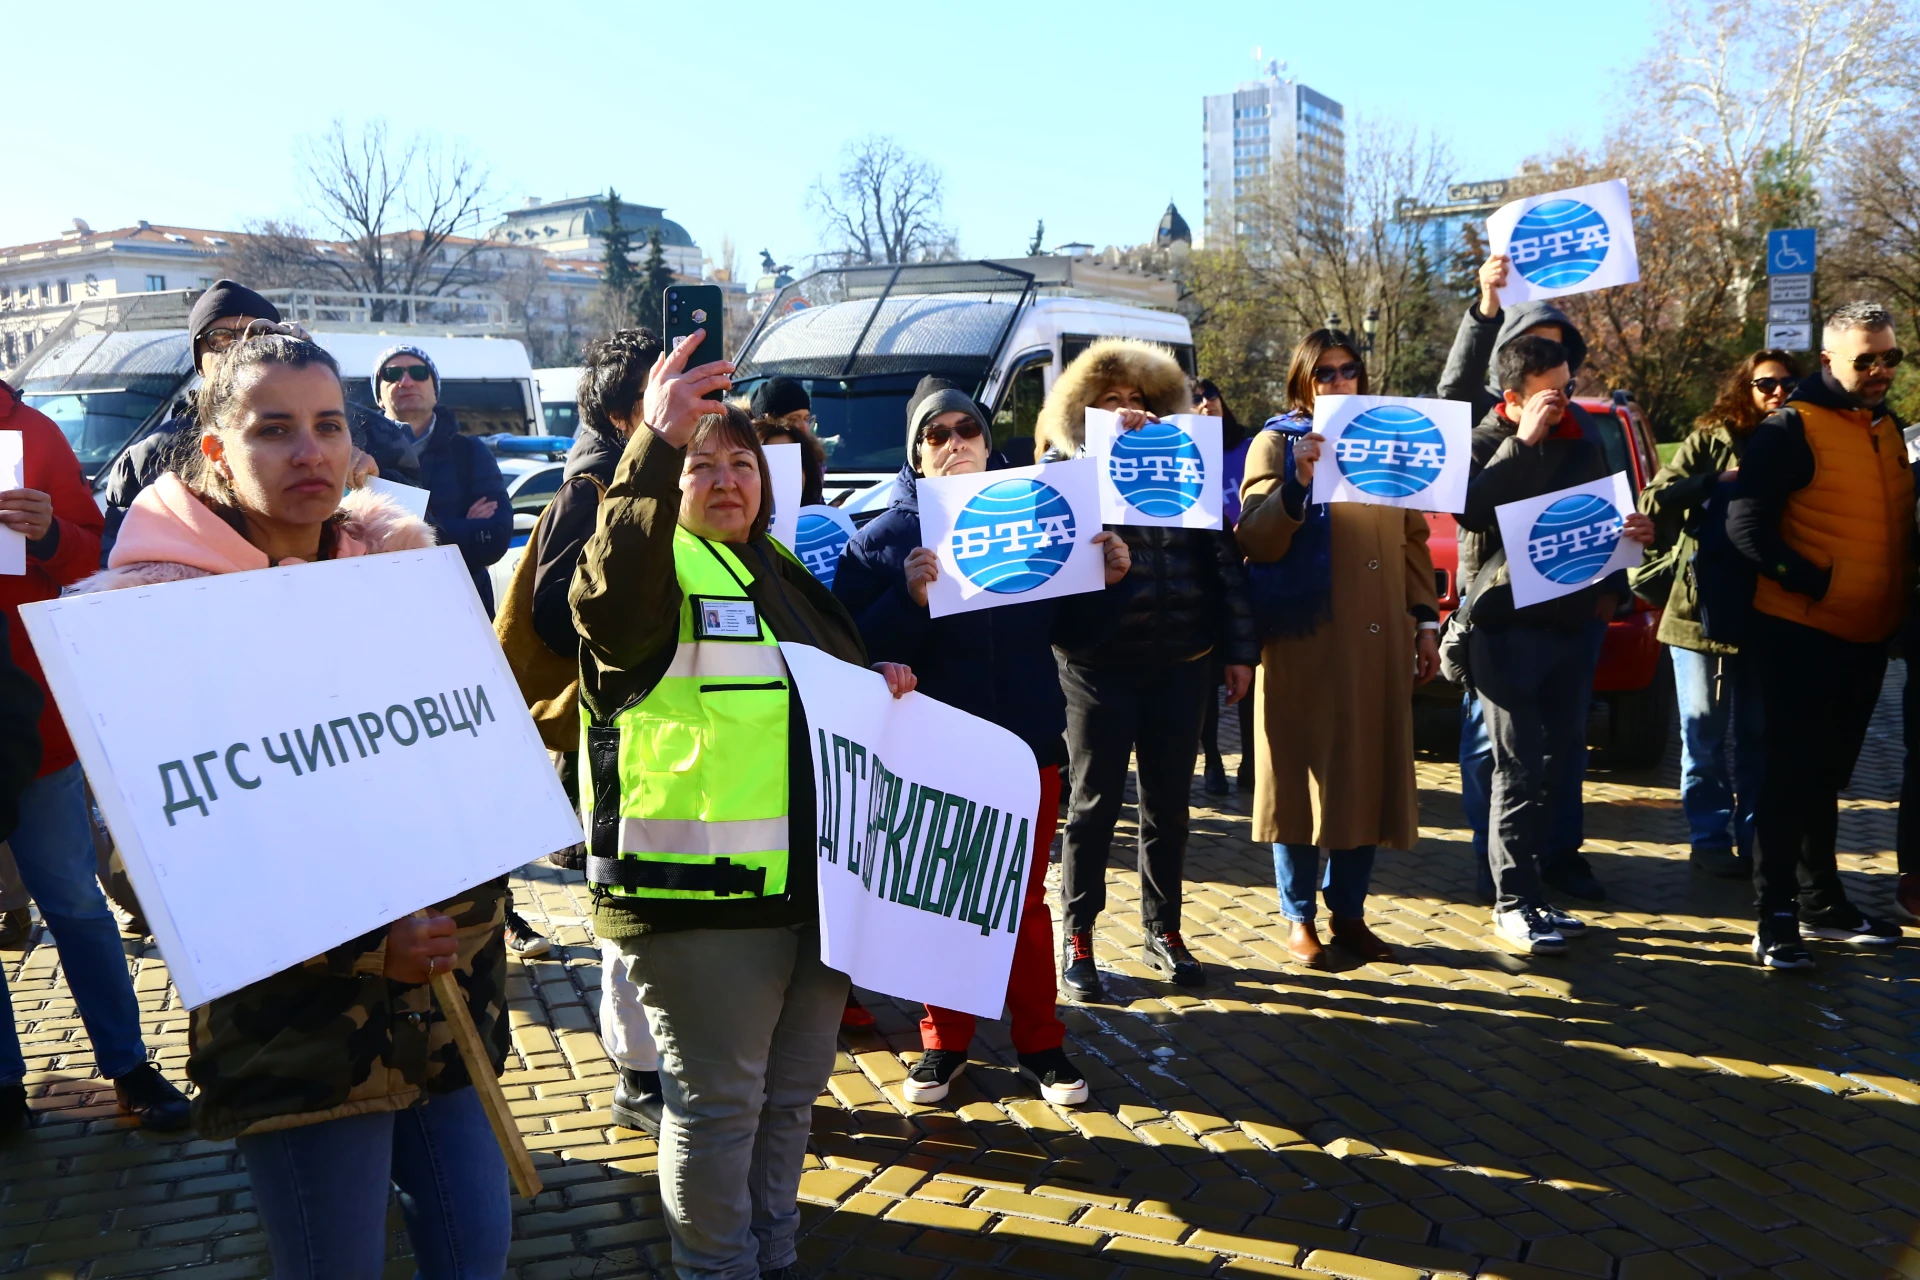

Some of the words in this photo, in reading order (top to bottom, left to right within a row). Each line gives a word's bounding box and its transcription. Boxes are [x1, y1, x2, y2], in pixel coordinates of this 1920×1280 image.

[1448, 183, 1504, 201] GRAND
[1510, 224, 1610, 264] БТА
[1109, 455, 1205, 485] БТА
[1336, 438, 1446, 469] БТА
[952, 514, 1076, 560] БТА
[1528, 517, 1623, 563] БТА
[158, 742, 262, 827] ДГС
[261, 684, 496, 777] ЧИПРОВЦИ
[818, 728, 867, 876] ДГС
